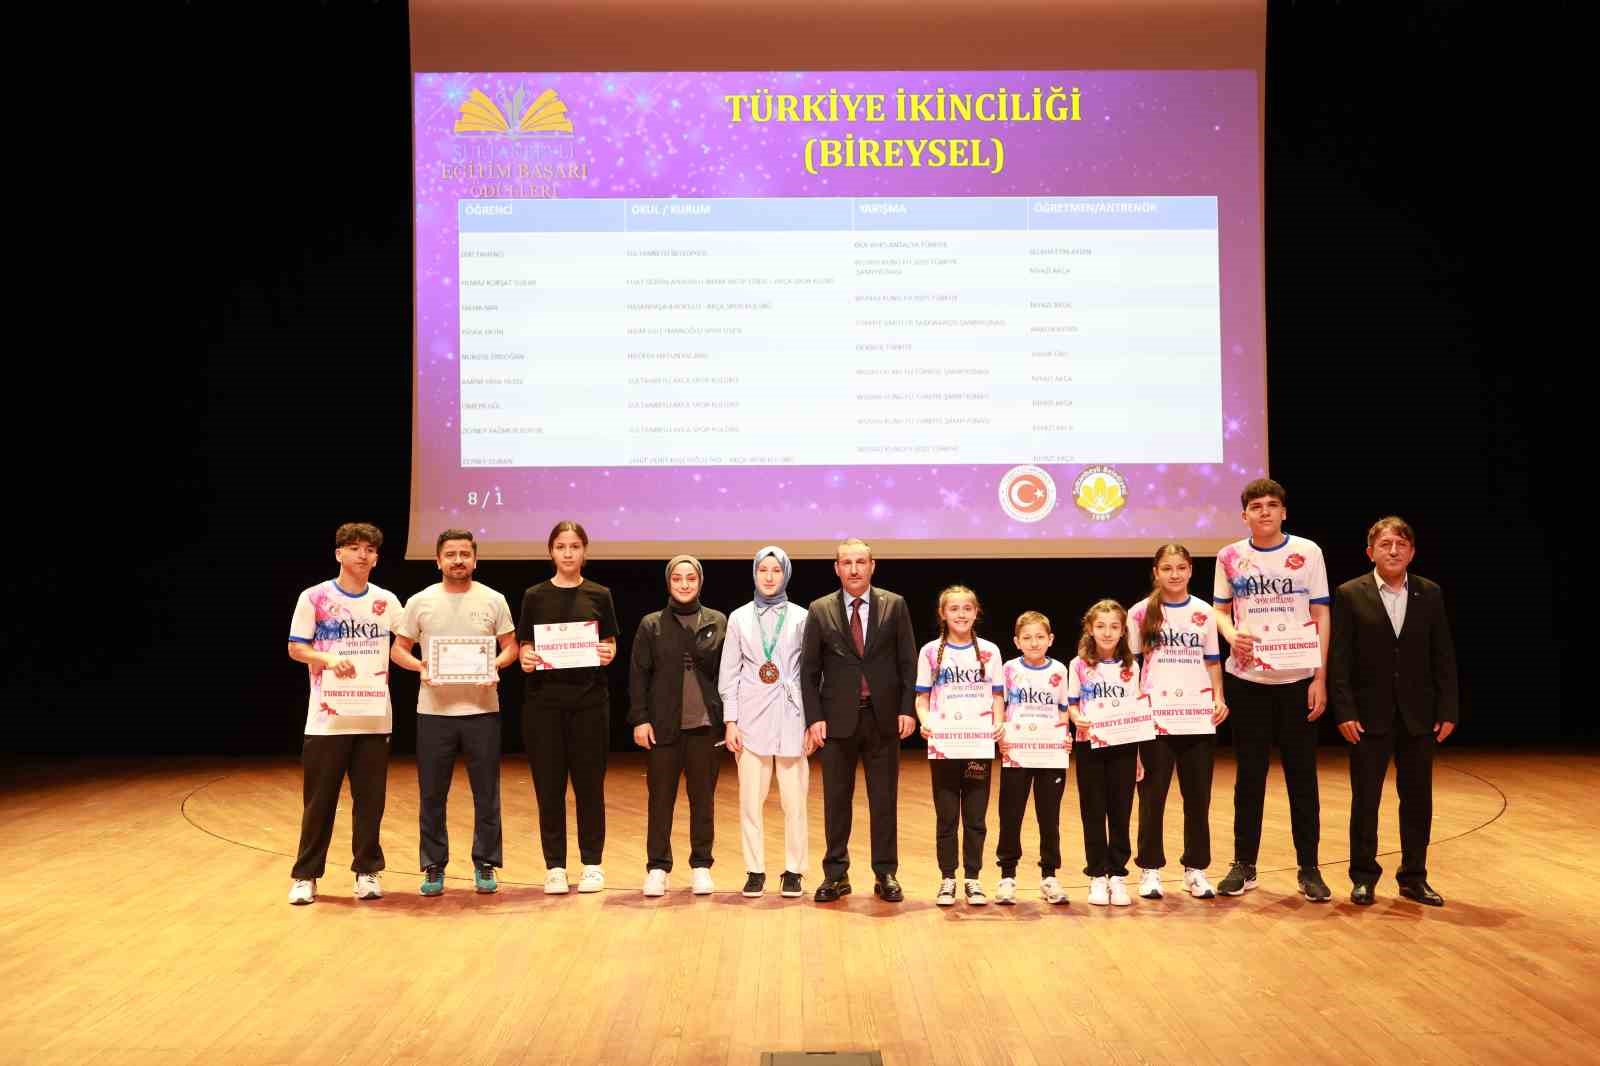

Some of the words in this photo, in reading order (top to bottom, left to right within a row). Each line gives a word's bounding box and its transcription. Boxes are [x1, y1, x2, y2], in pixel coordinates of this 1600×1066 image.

[725, 88, 885, 122] TÜRKİYE
[895, 86, 1082, 122] İKİNCİLİĞİ
[804, 133, 1005, 174] (BİREYSEL)
